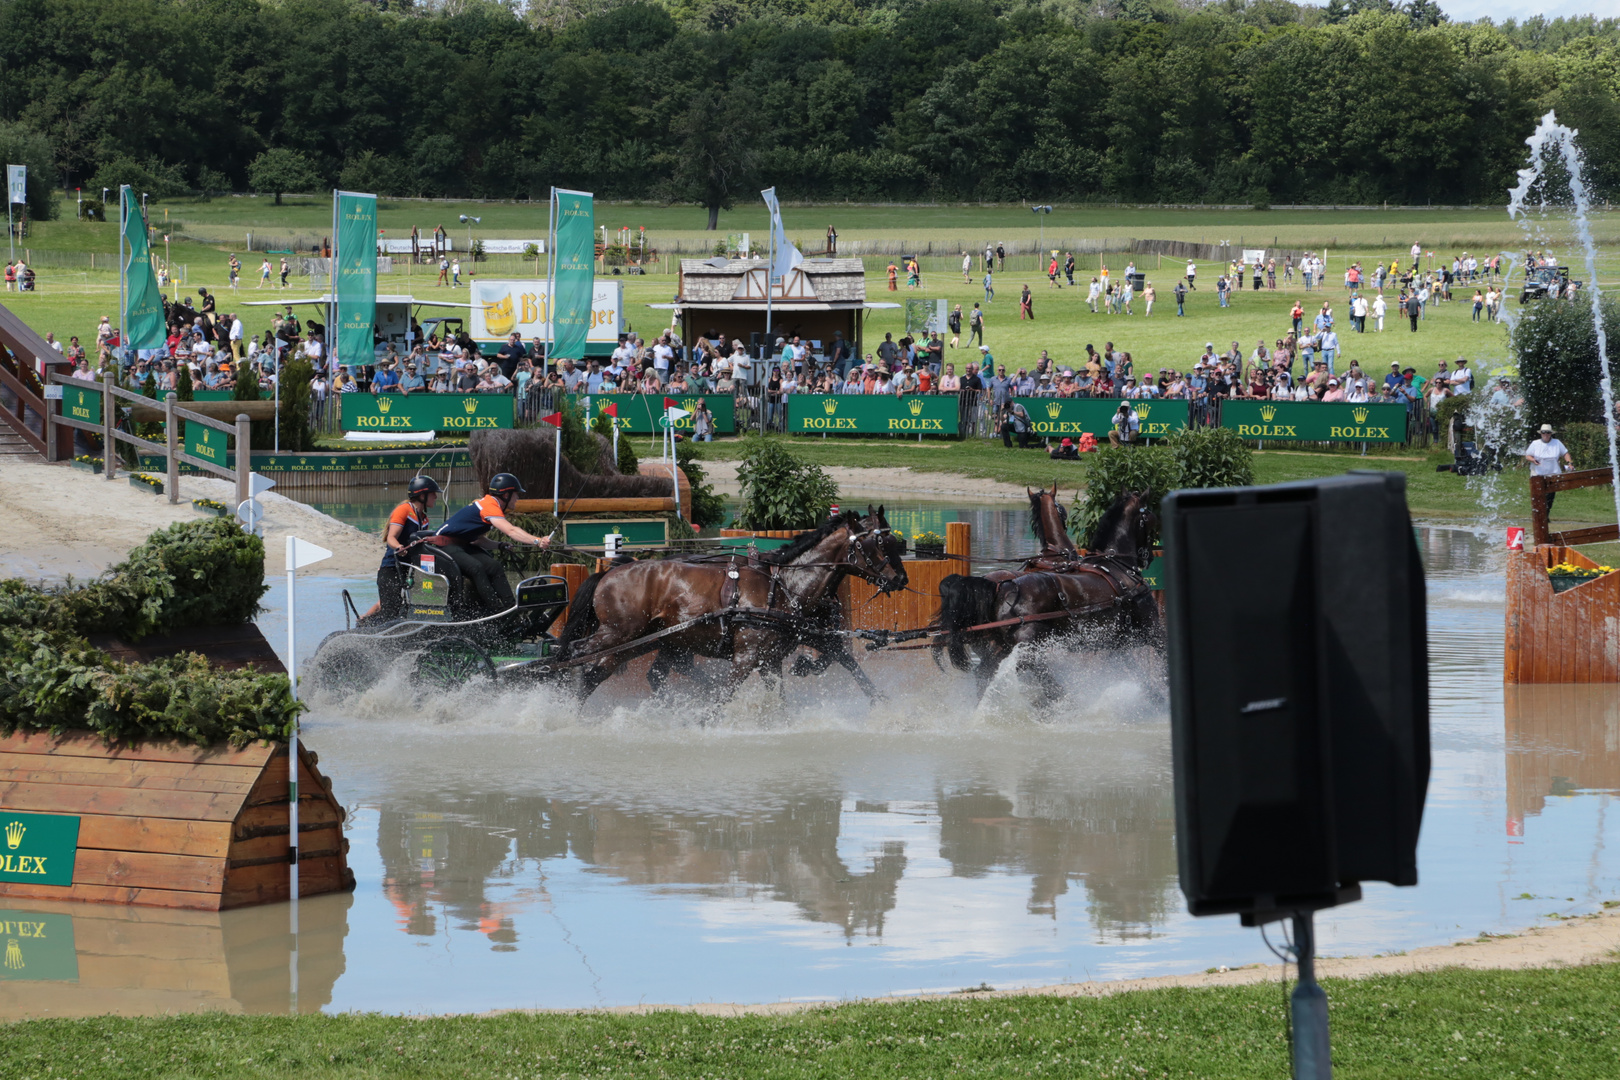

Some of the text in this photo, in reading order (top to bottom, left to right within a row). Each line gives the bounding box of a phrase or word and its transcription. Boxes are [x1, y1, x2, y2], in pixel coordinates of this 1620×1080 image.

[12, 182, 23, 192] 10
[132, 306, 158, 316] ROLEX
[72, 406, 90, 418] ROLEX
[356, 416, 498, 428] ROLEX ROLEX
[582, 417, 718, 428] OEX OLX
[803, 418, 943, 430] ROLEX ROLEX
[1030, 422, 1170, 434] ROLEX LEX
[1238, 424, 1389, 438] ROLEX ROLEX
[196, 444, 215, 458] ROLEX
[1512, 530, 1524, 548] A
[615, 538, 622, 554] E
[422, 582, 433, 590] KR
